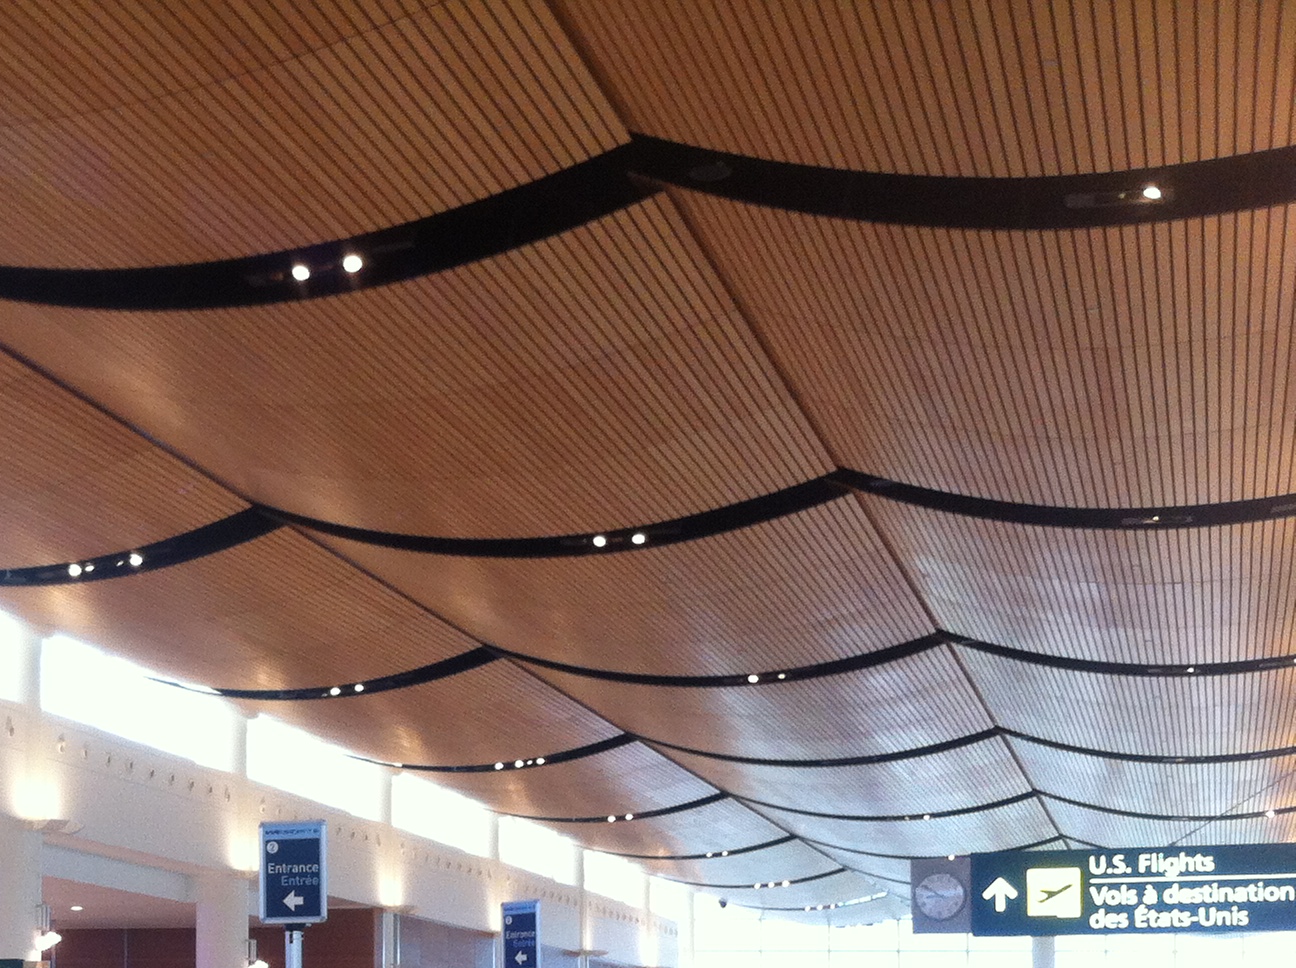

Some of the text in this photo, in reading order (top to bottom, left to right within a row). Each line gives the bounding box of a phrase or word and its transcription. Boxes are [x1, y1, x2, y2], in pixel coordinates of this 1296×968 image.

[267, 862, 319, 874] Entrance
[1089, 852, 1216, 878] U.S. Flights
[281, 874, 319, 886] Entrée
[1089, 881, 1295, 906] Vols à destination
[1089, 903, 1250, 929] des États-Unis
